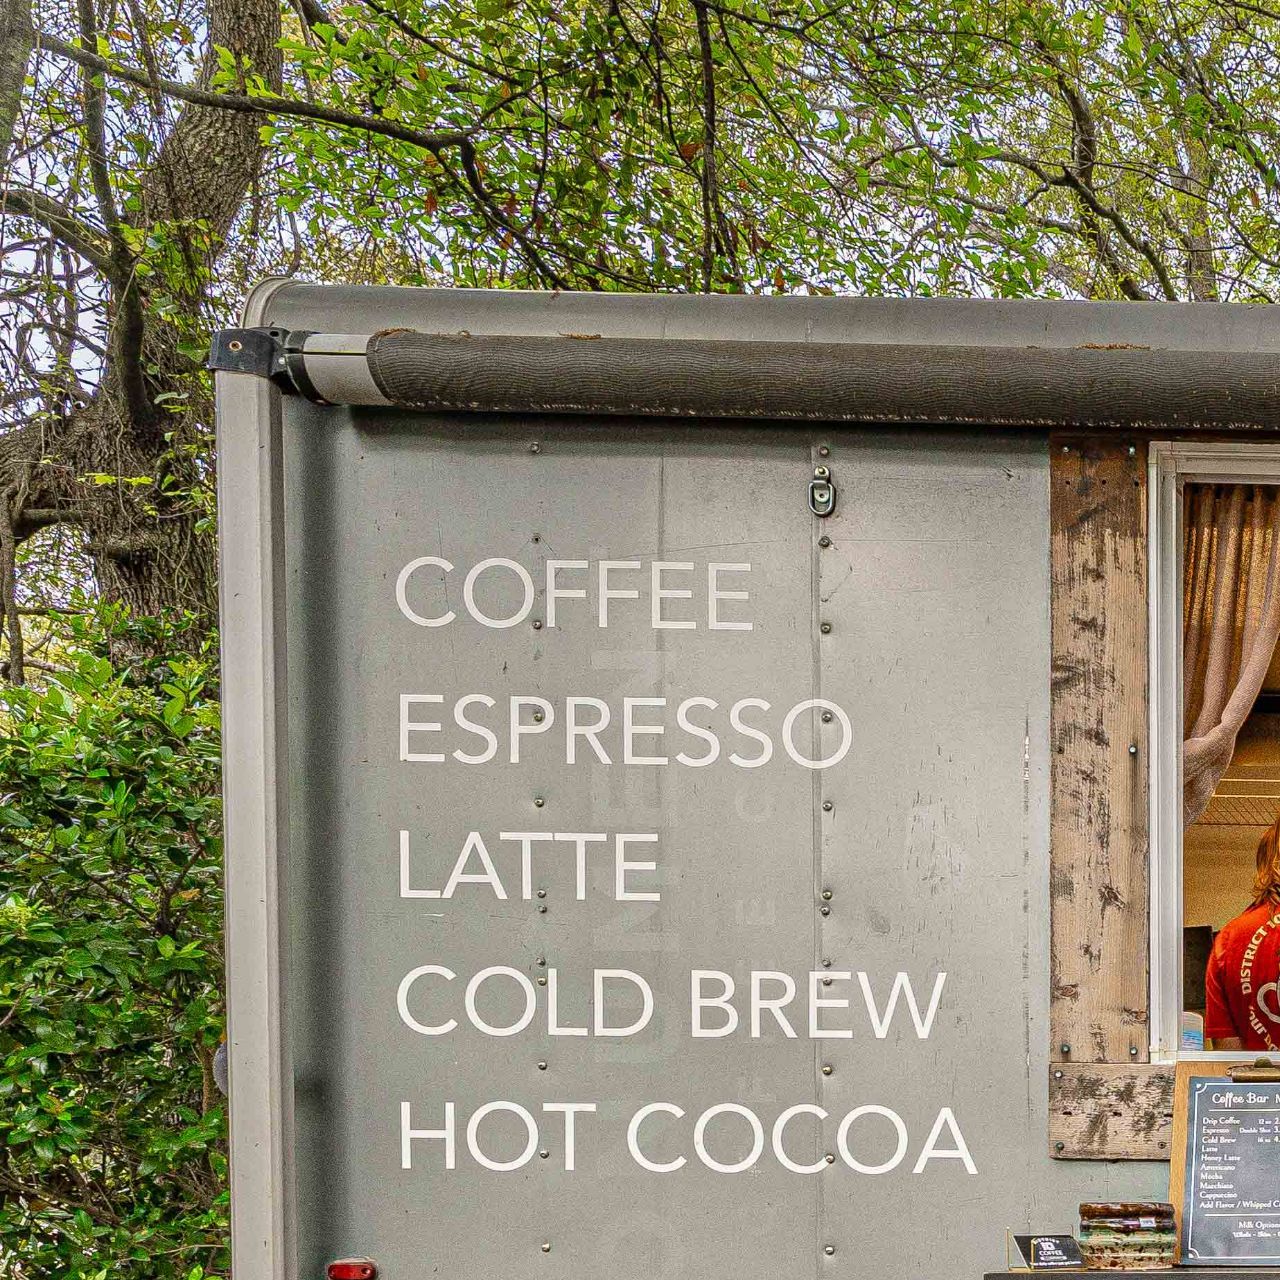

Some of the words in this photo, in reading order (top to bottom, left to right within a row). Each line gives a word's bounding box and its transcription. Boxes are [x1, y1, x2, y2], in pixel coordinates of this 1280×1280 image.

[395, 556, 753, 631] COFFEE
[399, 694, 852, 769] ESPRESSO
[399, 830, 661, 901] LATTE
[1241, 926, 1268, 994] DISTRICT
[397, 965, 654, 1036] COLD
[691, 970, 946, 1039] BREW
[1212, 1092, 1245, 1108] Coffee
[1246, 1092, 1269, 1103] Bar
[1219, 1116, 1240, 1125] Coffee
[401, 1101, 596, 1171] HOT
[626, 1102, 978, 1174] COCOA
[1242, 1200, 1272, 1210] Whipped
